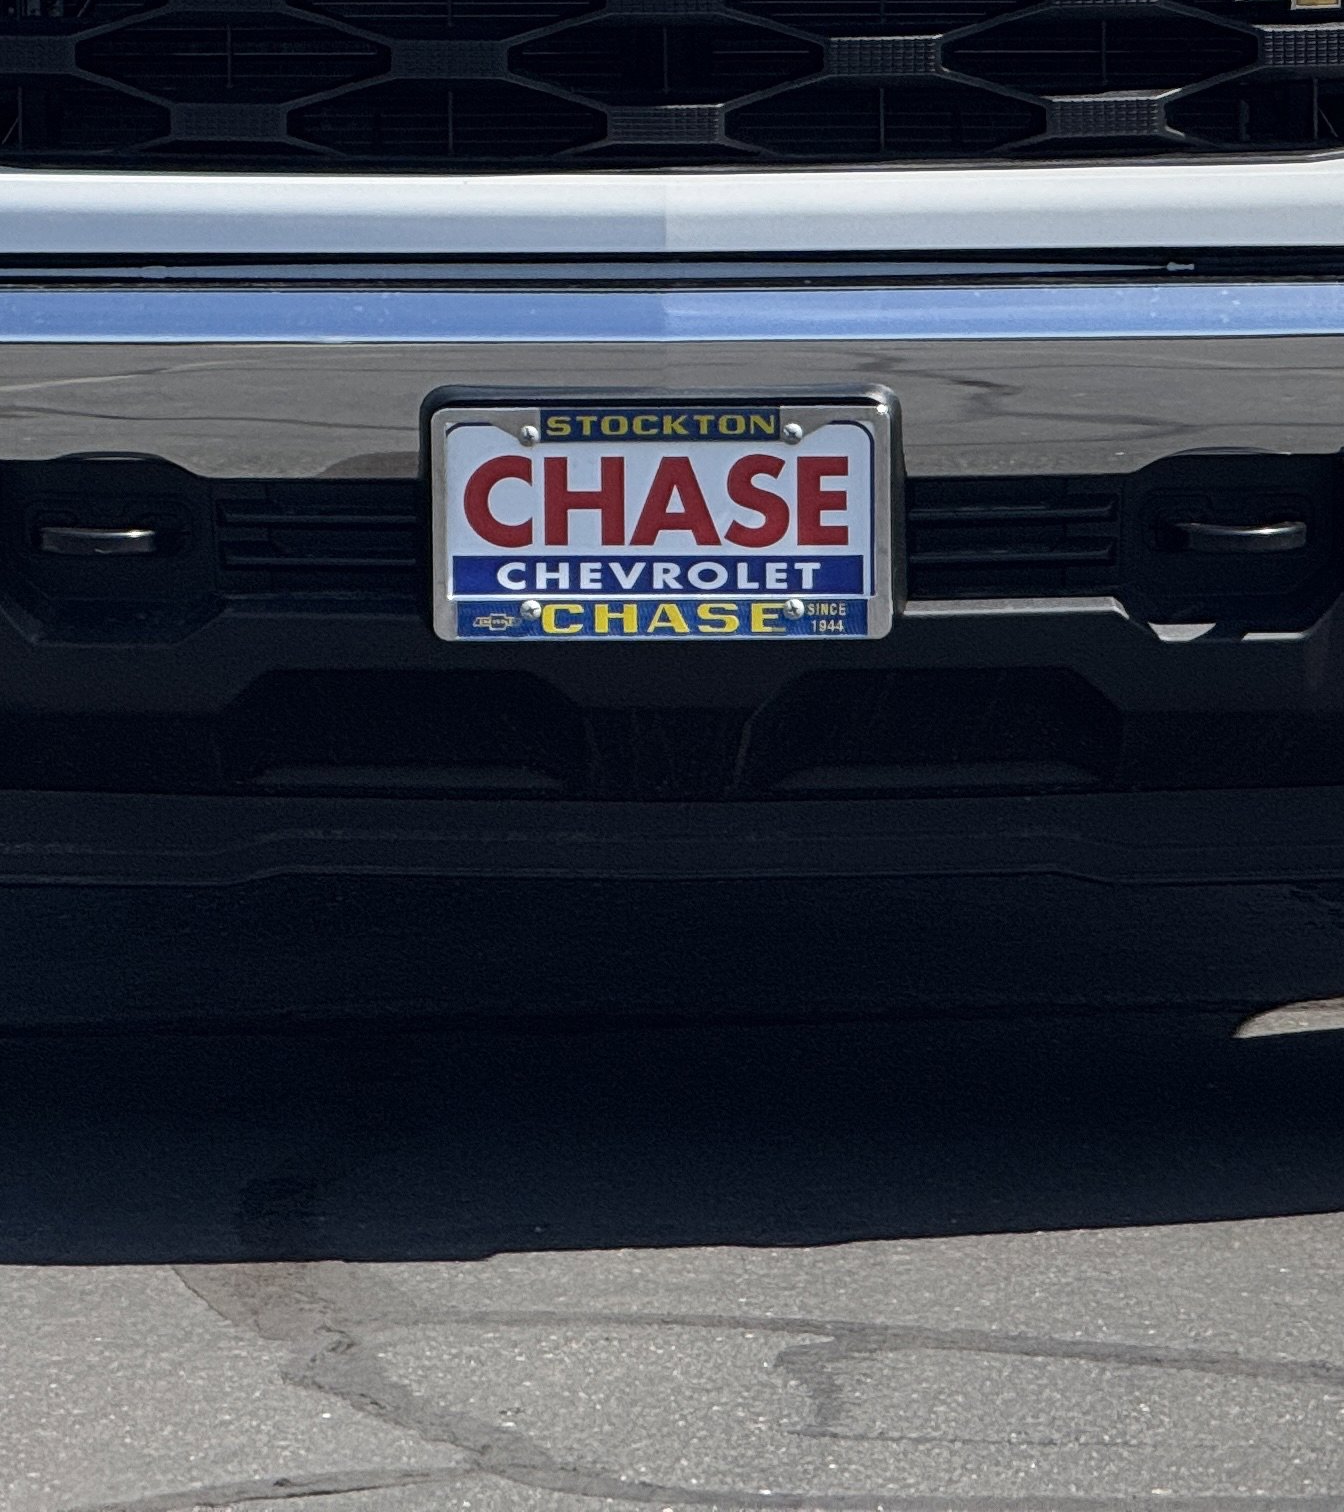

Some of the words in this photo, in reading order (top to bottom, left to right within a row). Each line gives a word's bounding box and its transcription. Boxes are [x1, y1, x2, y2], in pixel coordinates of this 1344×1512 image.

[546, 414, 776, 437] STOCKTON
[463, 454, 850, 548] CHASE
[496, 561, 822, 590] CHEVROLET
[541, 602, 787, 634] CHASE
[807, 602, 847, 617] SINCE
[811, 619, 845, 634] 1944
